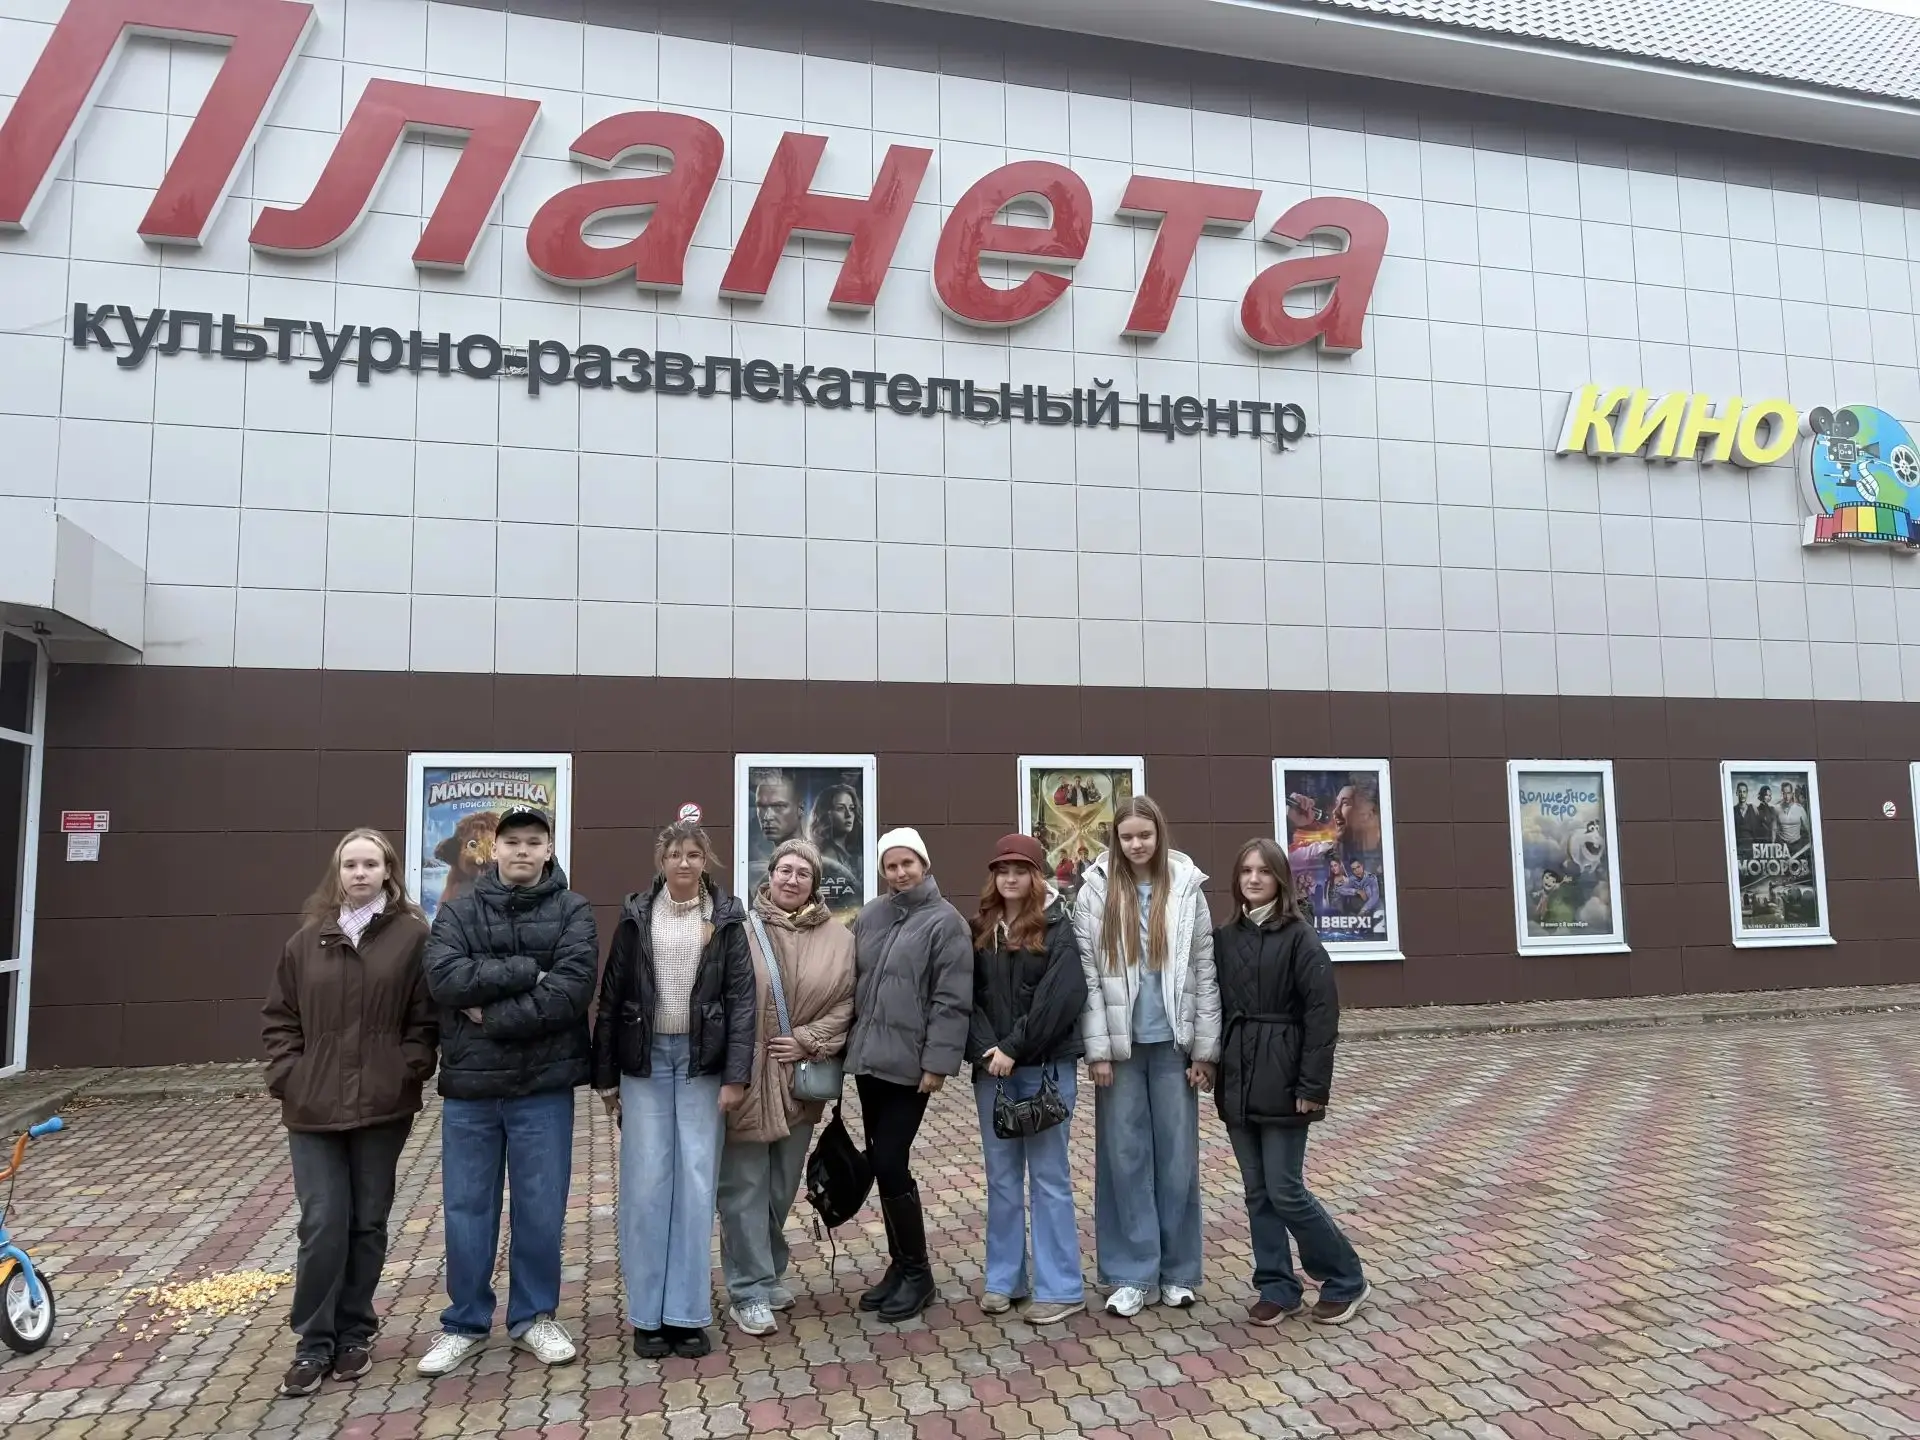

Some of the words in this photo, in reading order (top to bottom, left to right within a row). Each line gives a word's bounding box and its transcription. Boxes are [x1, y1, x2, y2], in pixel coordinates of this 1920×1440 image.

[0, 0, 1390, 356] Планета
[71, 301, 1120, 430] культурно-развлекательный
[1138, 392, 1308, 452] центр
[1557, 384, 1799, 466] КИНО
[451, 769, 530, 782] ПРИКЛЮЧЕНИЯ
[429, 781, 548, 805] МАМОНТЁНКА
[460, 801, 498, 809] ПОИСКАХ
[512, 804, 532, 814] NY
[1752, 842, 1791, 859] БИТВА
[1737, 859, 1810, 877] МОТОРОВ
[1372, 909, 1386, 933] 2
